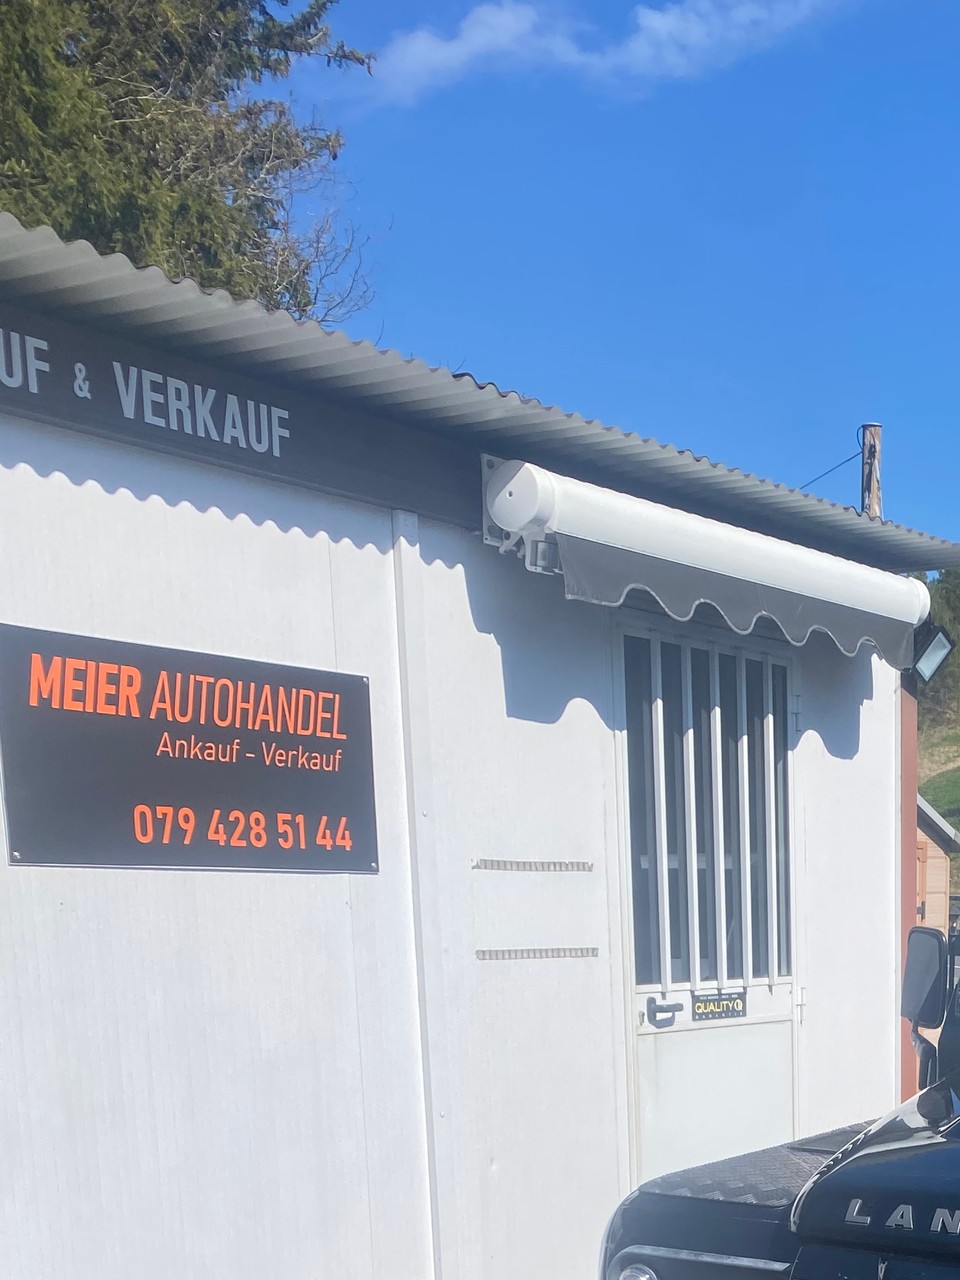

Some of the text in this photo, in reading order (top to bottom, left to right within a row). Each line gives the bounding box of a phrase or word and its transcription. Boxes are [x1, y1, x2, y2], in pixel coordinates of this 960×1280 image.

[74, 362, 92, 400] &
[112, 361, 290, 457] VERKAUF
[29, 653, 347, 740] MEIER AUTOHANDEL
[156, 732, 240, 763] Ankauf
[262, 741, 342, 772] Verkauf
[133, 804, 352, 851] 079 428 51 44
[695, 1001, 733, 1013] QUALITY
